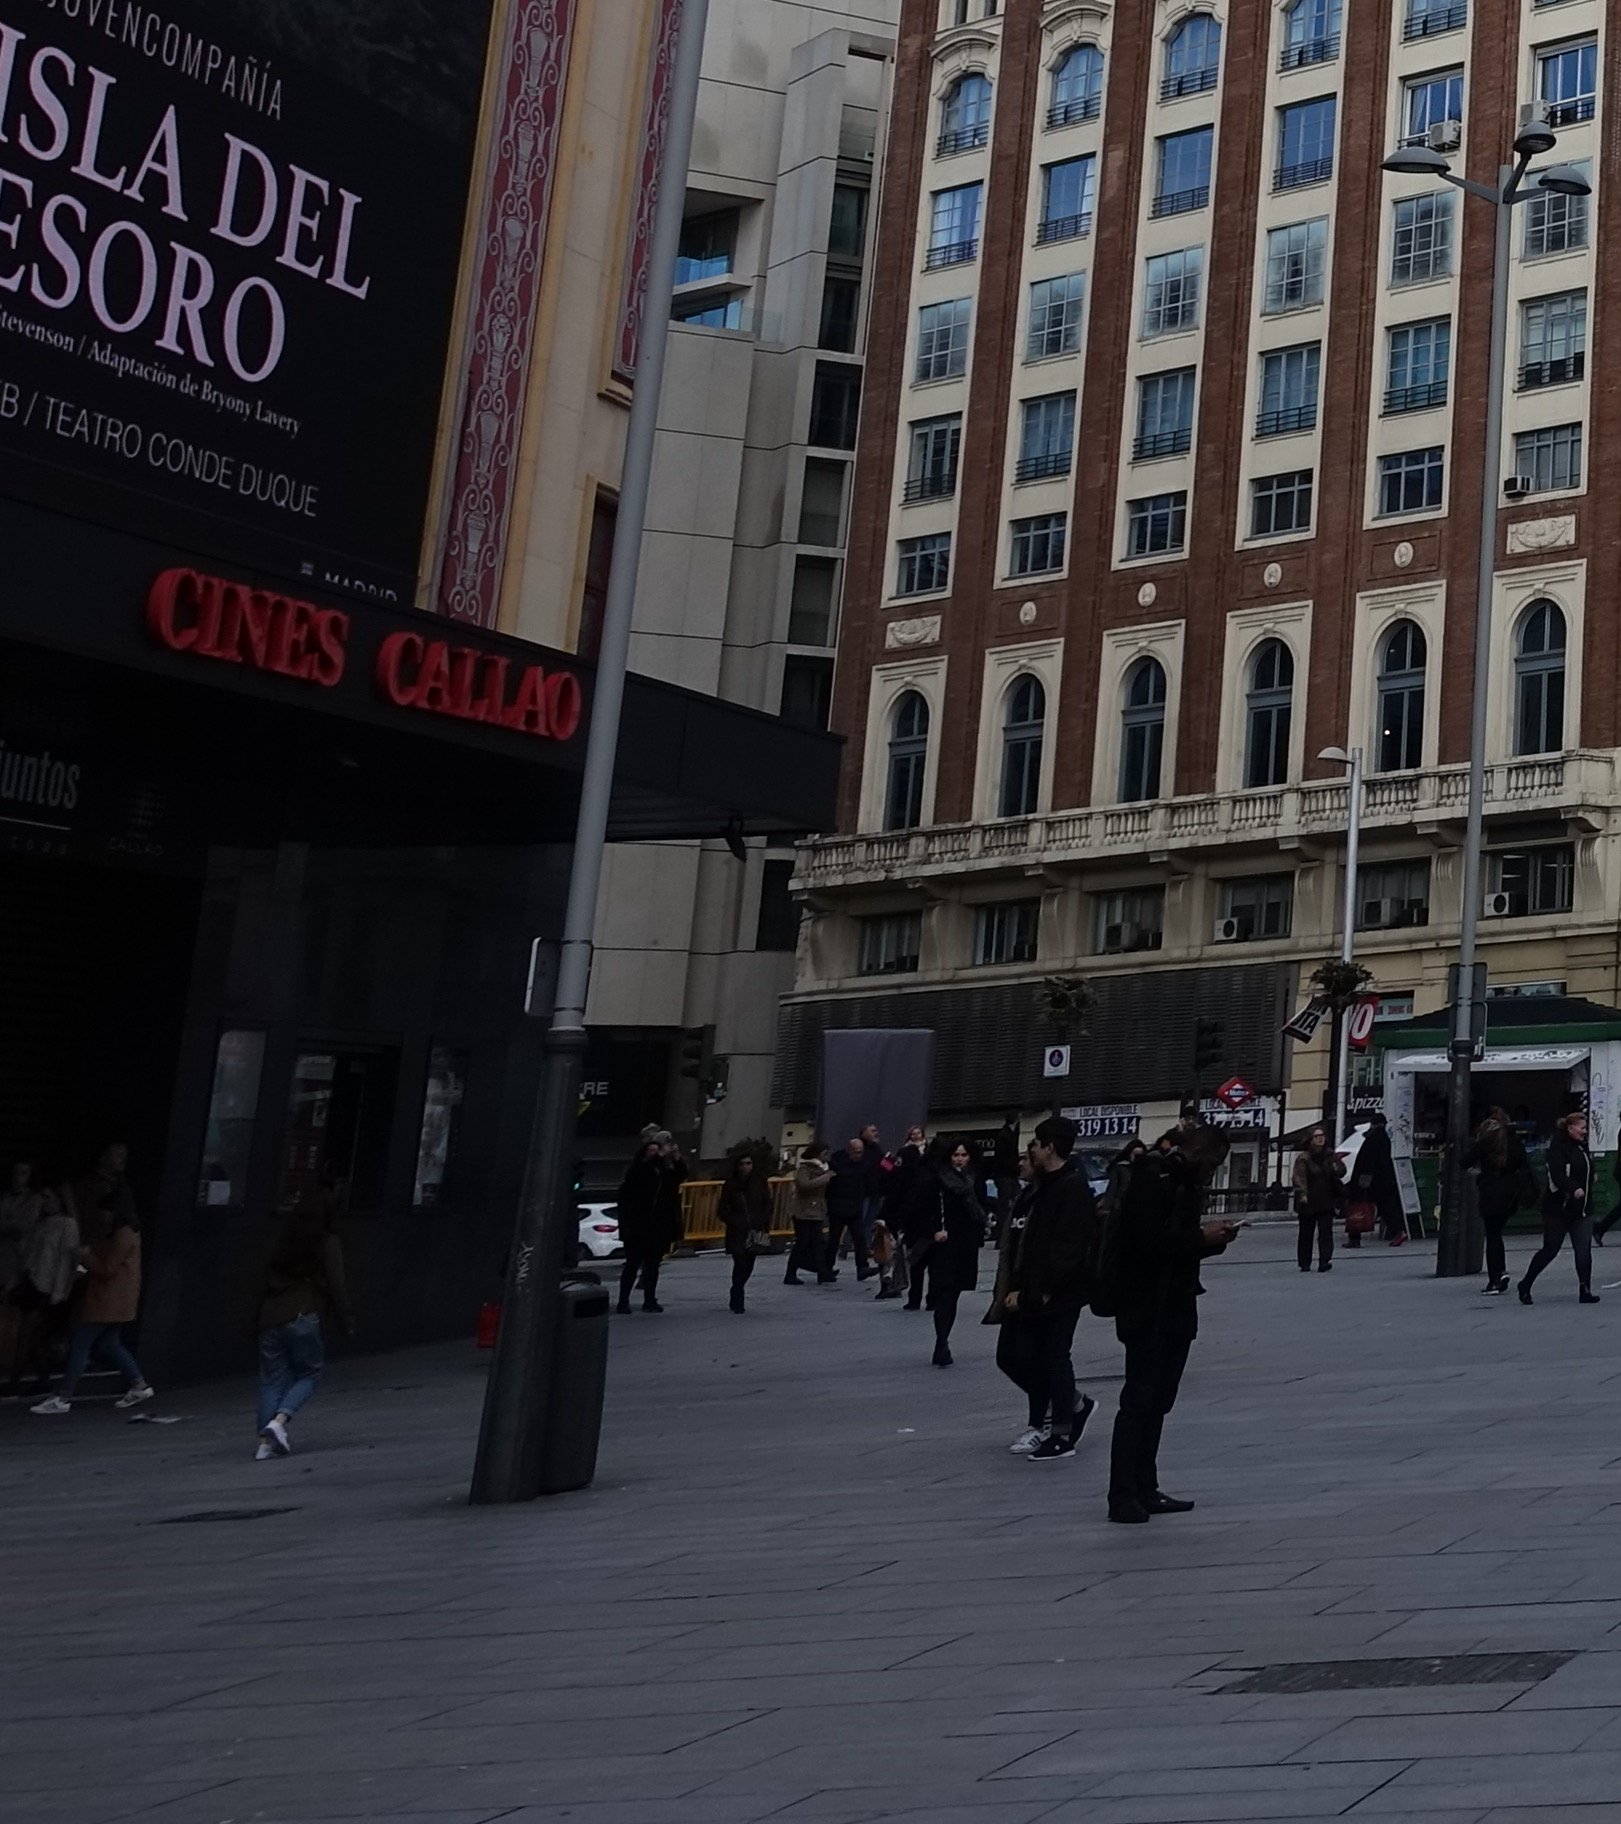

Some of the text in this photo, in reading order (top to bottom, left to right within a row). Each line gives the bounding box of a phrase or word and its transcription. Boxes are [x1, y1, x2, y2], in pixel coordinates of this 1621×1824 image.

[0, 21, 372, 302] ISLA DEL
[0, 168, 286, 383] ESORO
[45, 395, 142, 459] TEATRO
[149, 432, 236, 490] CONDE
[239, 462, 320, 517] DUQUE
[88, 339, 178, 390] Adaptación
[180, 370, 199, 397] de
[200, 379, 252, 422] Bryony
[255, 400, 302, 439] Lavery
[146, 567, 583, 741] CINES CALLAO
[1077, 1116, 1138, 1137] 319 13 14
